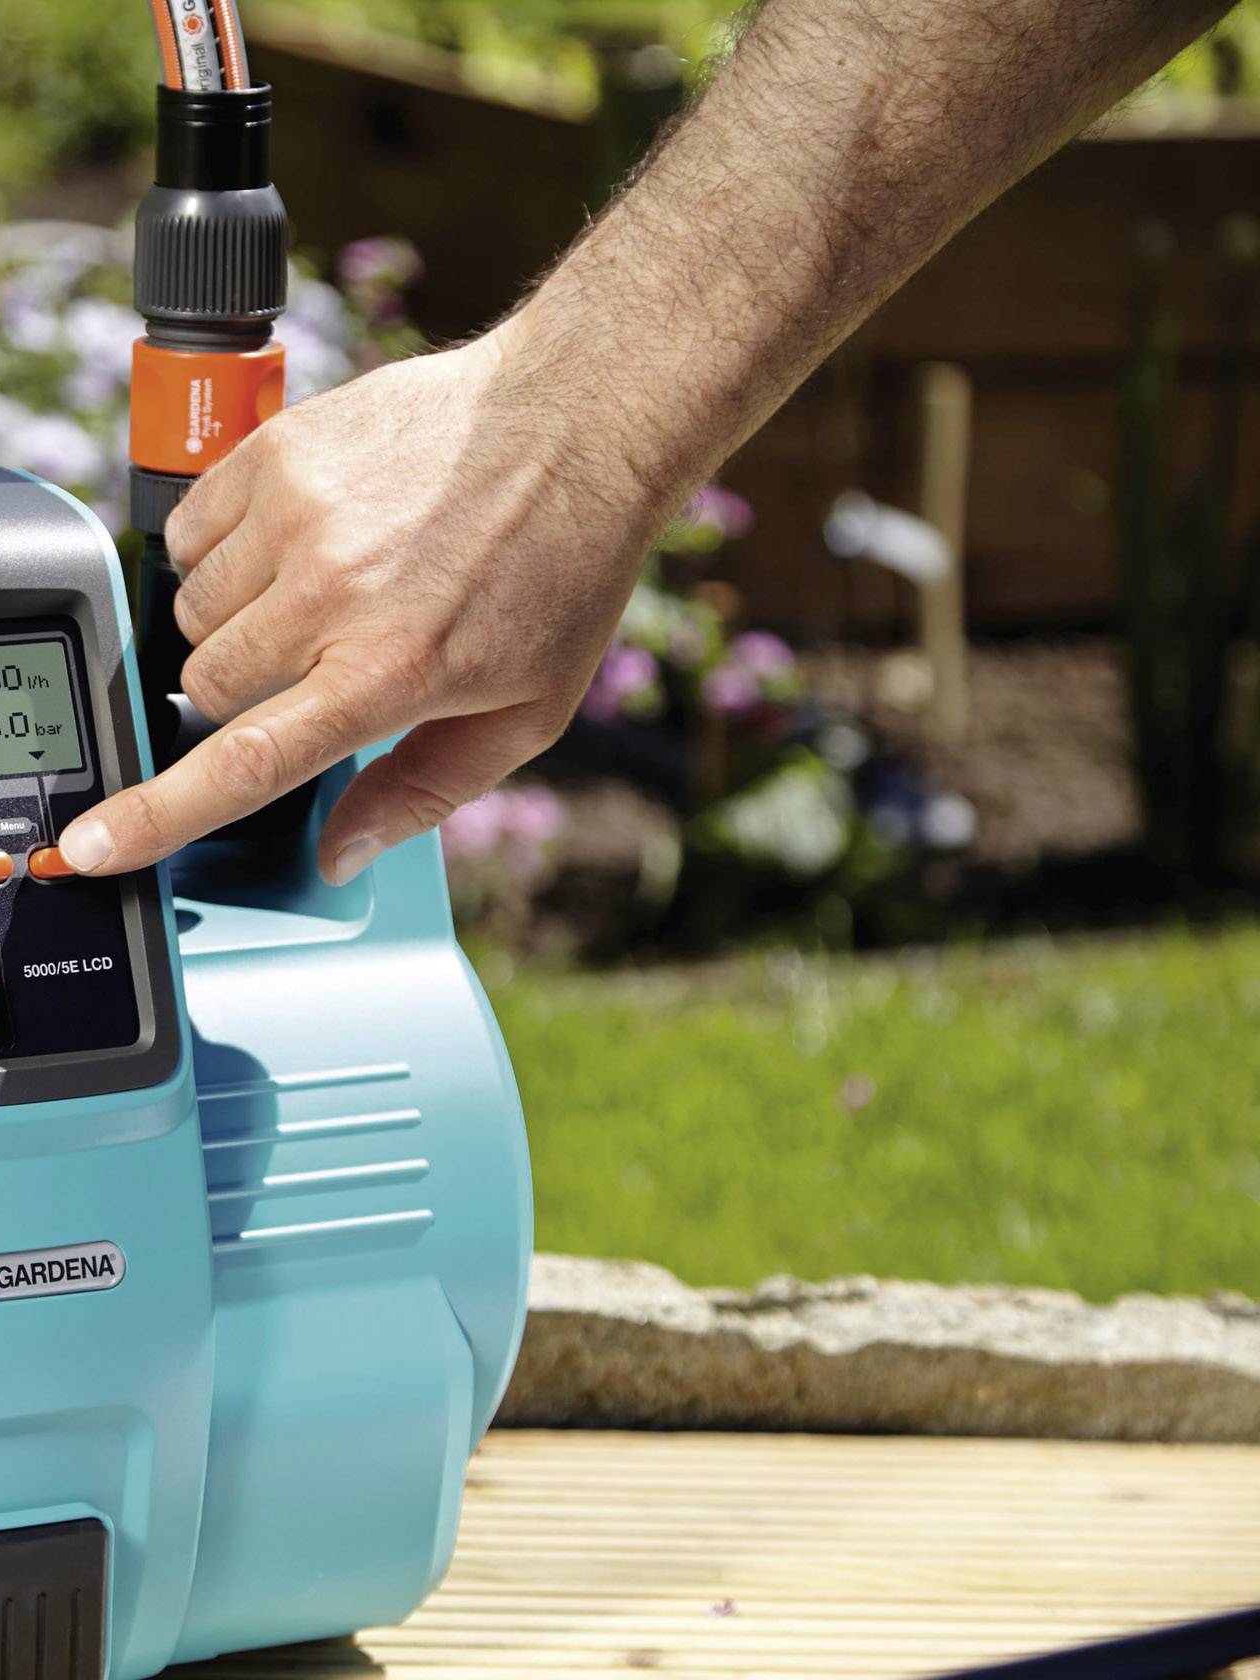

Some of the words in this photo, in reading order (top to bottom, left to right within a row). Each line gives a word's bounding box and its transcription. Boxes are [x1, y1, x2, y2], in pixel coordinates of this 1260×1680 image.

[190, 379, 201, 437] GARDENA
[27, 675, 50, 690] l/h
[35, 722, 63, 737] bar
[0, 821, 25, 831] Menu
[23, 959, 80, 978] 5000/5E
[82, 956, 114, 973] LCD
